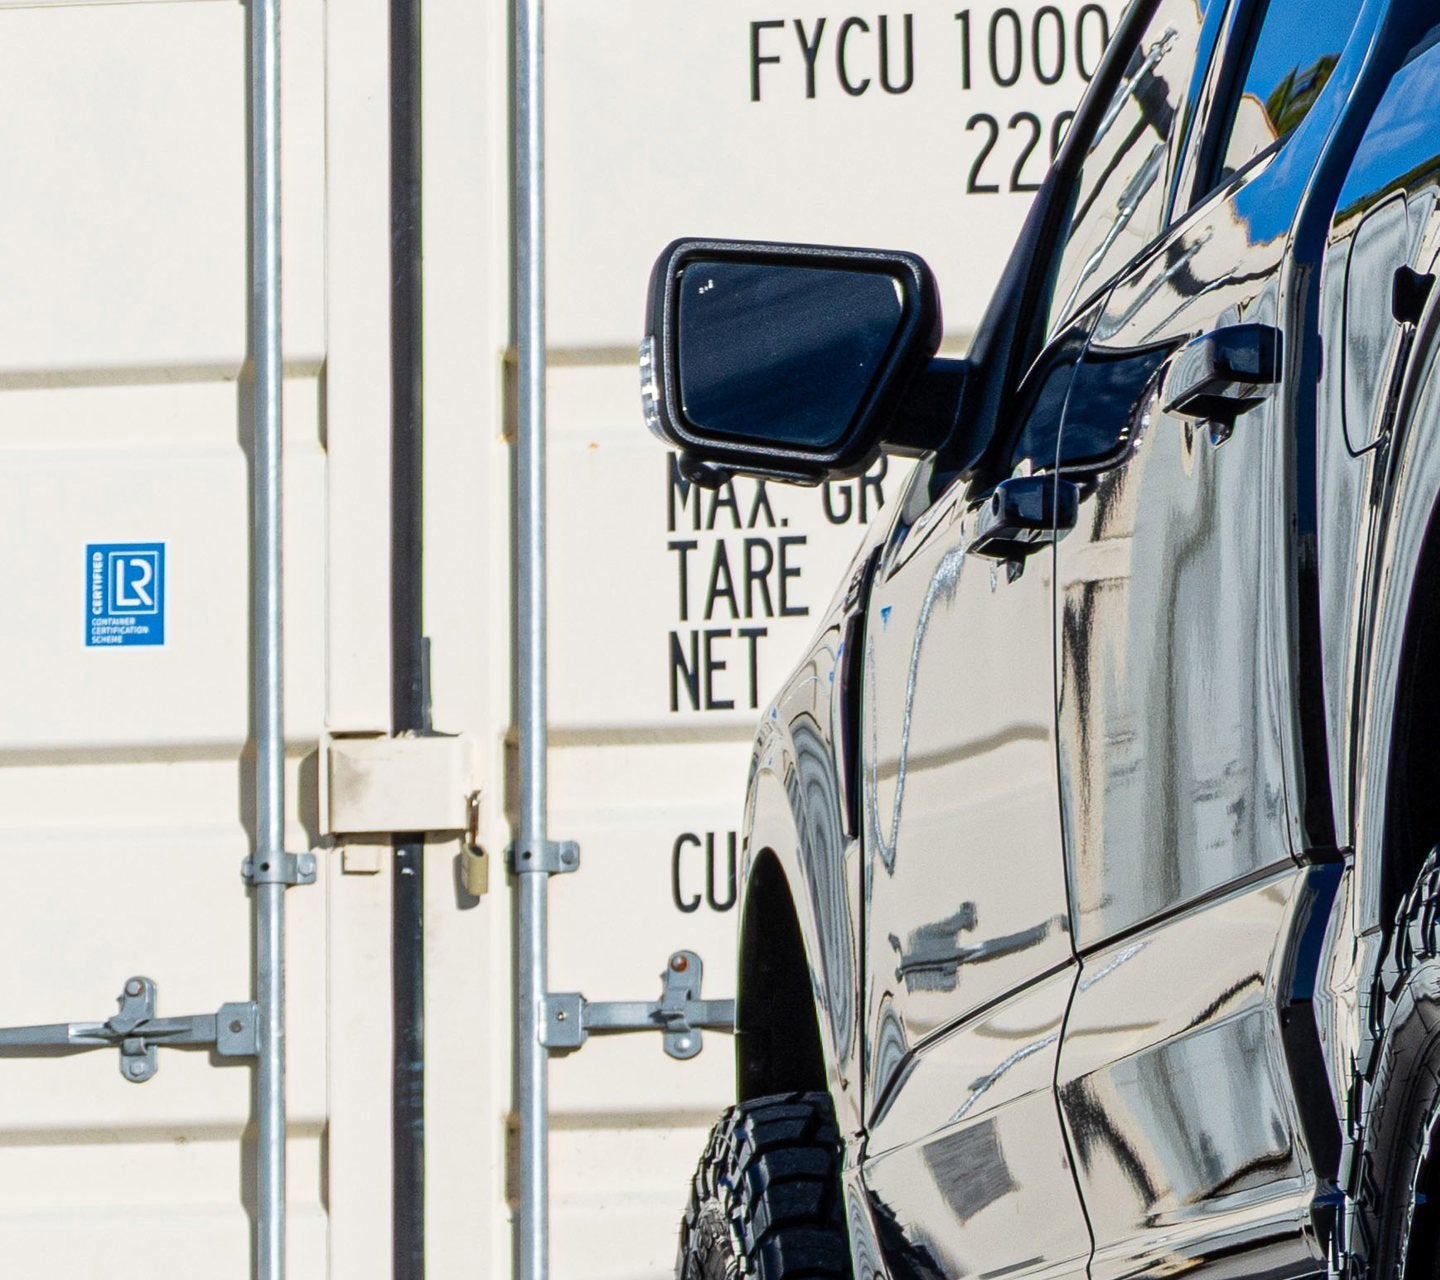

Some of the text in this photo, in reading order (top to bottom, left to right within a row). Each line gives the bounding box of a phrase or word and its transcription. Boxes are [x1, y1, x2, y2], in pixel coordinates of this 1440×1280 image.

[749, 3, 1128, 102] FYCU 1000
[92, 551, 103, 616] CERTIFIED
[116, 558, 154, 607] LR
[668, 535, 809, 621] TARE
[668, 627, 767, 712] NET
